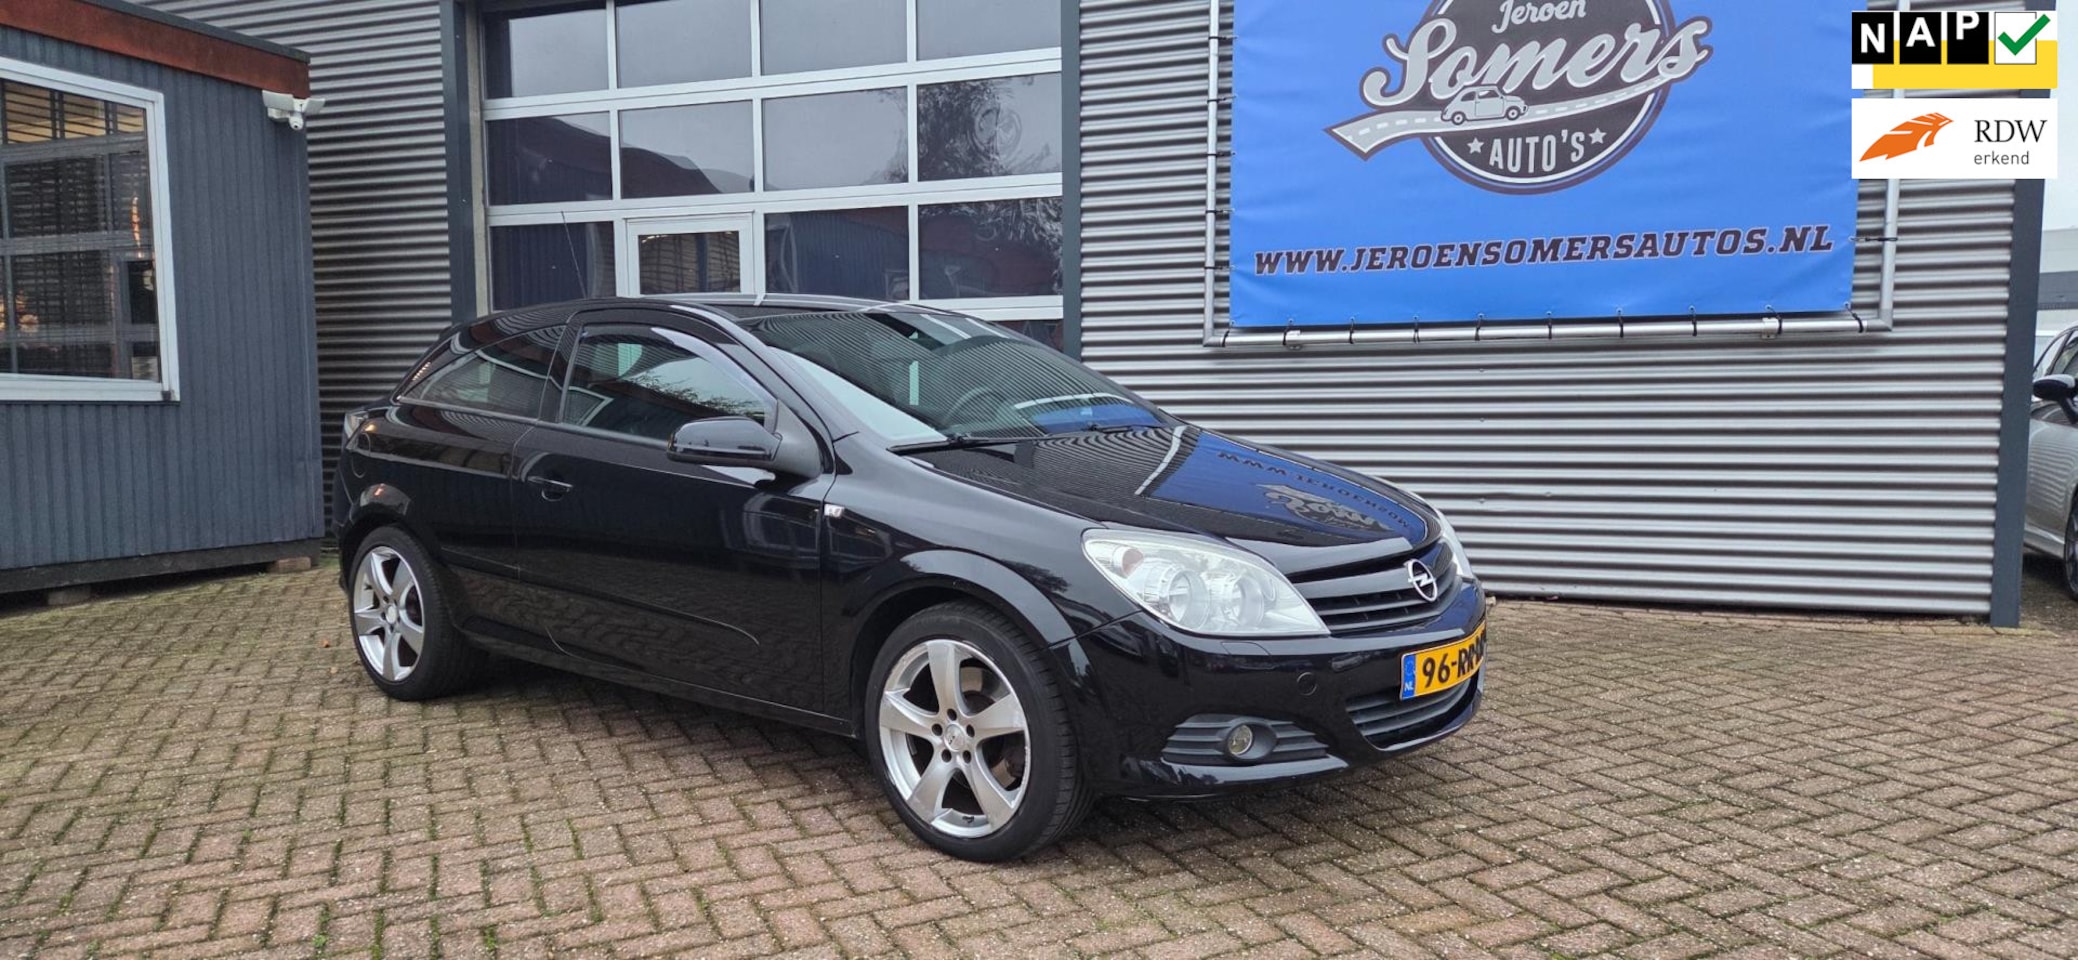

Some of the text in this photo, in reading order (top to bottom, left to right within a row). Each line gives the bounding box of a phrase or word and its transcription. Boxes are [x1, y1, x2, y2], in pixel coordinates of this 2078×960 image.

[1491, 0, 1586, 34] Jeroen
[1363, 17, 1709, 106] Somers
[1488, 128, 1585, 174] AUTO'S
[1254, 225, 1833, 275] WWW.JEROENSOMERSAUTOS.NL
